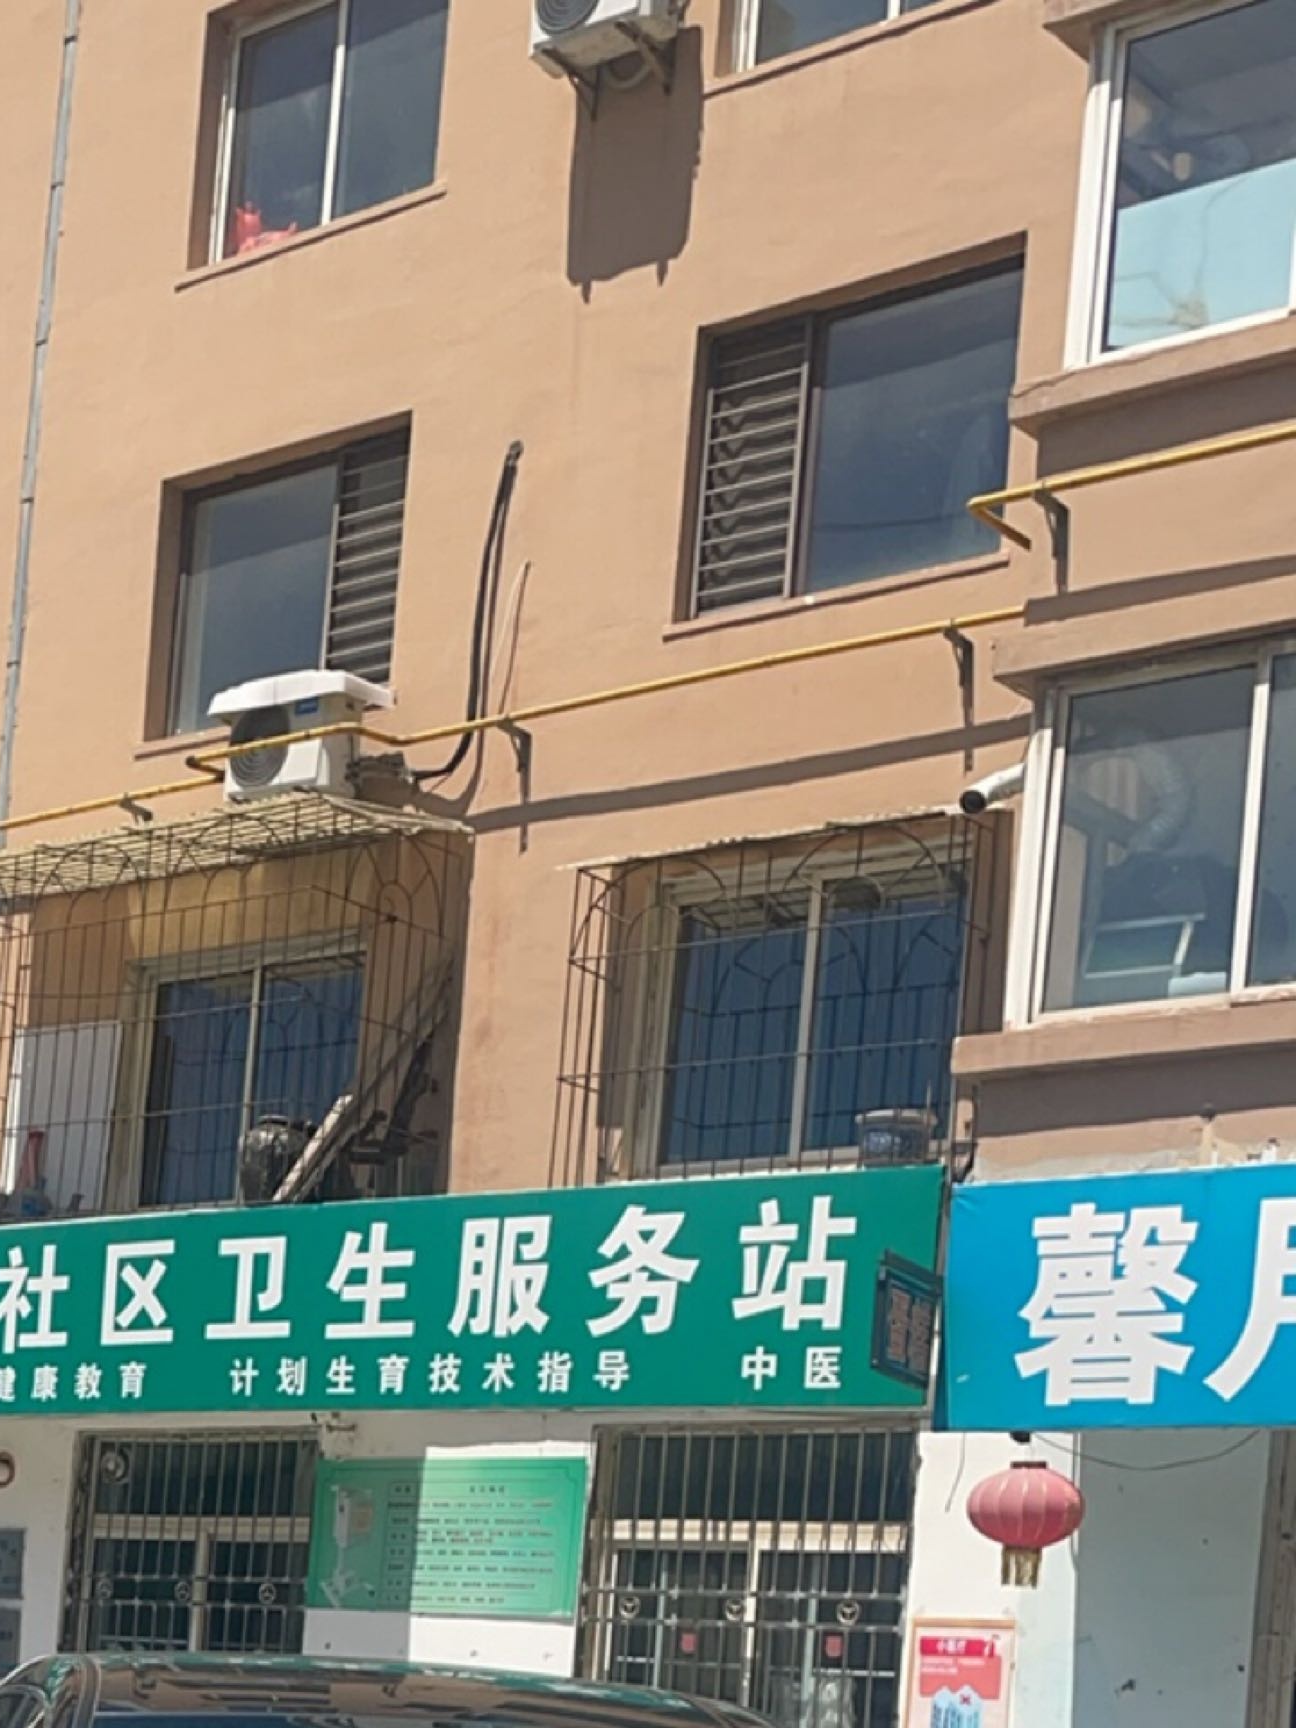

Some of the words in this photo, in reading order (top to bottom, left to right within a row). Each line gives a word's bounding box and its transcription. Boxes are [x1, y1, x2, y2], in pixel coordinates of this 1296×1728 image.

[229, 1351, 630, 1396] 计划生育技术指导
[740, 1345, 842, 1391] 中医
